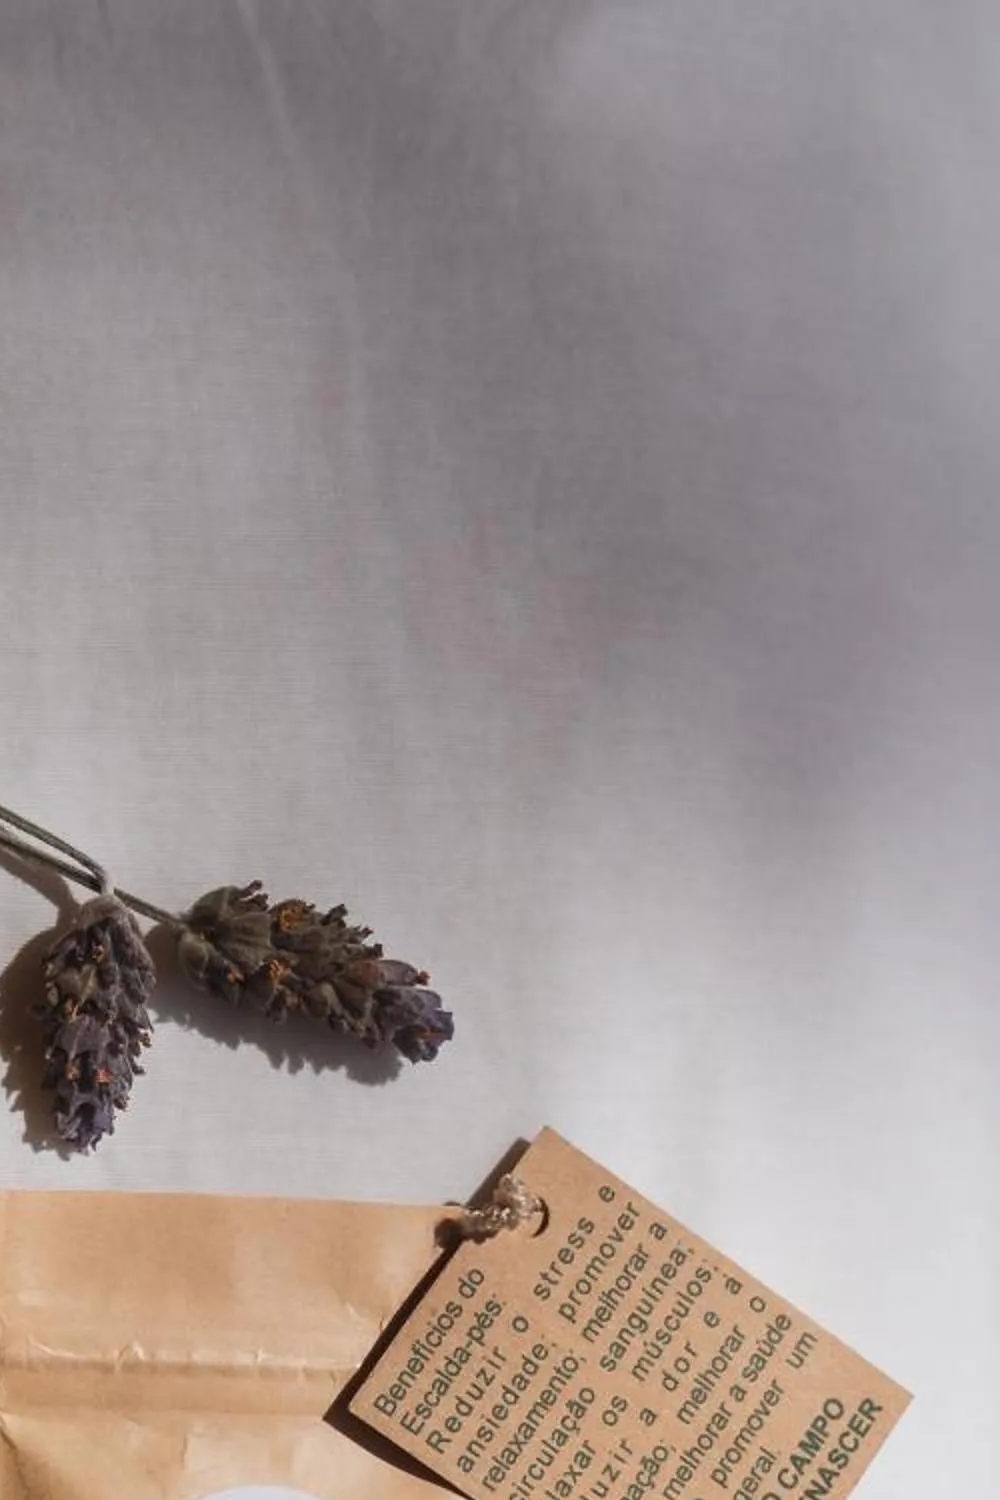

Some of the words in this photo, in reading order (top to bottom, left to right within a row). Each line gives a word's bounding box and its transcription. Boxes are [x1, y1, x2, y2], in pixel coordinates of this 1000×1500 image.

[425, 1346, 506, 1454] Reduzir
[512, 1316, 529, 1332] o
[534, 1218, 595, 1300] stress
[598, 1186, 615, 1203] e
[458, 1269, 484, 1299] do
[558, 1202, 640, 1324] promover
[581, 1243, 649, 1343] melhorar
[649, 1222, 667, 1240] a
[602, 1396, 628, 1426] os
[639, 1408, 658, 1426] a
[662, 1341, 697, 1392] dor
[704, 1312, 720, 1328] e
[676, 1325, 744, 1424] melhorar
[750, 1296, 766, 1313] o
[710, 1379, 784, 1489] promover
[786, 1332, 818, 1369] um
[730, 1385, 747, 1402] a
[742, 1314, 792, 1382] saúde
[778, 1398, 844, 1490] CAMPO
